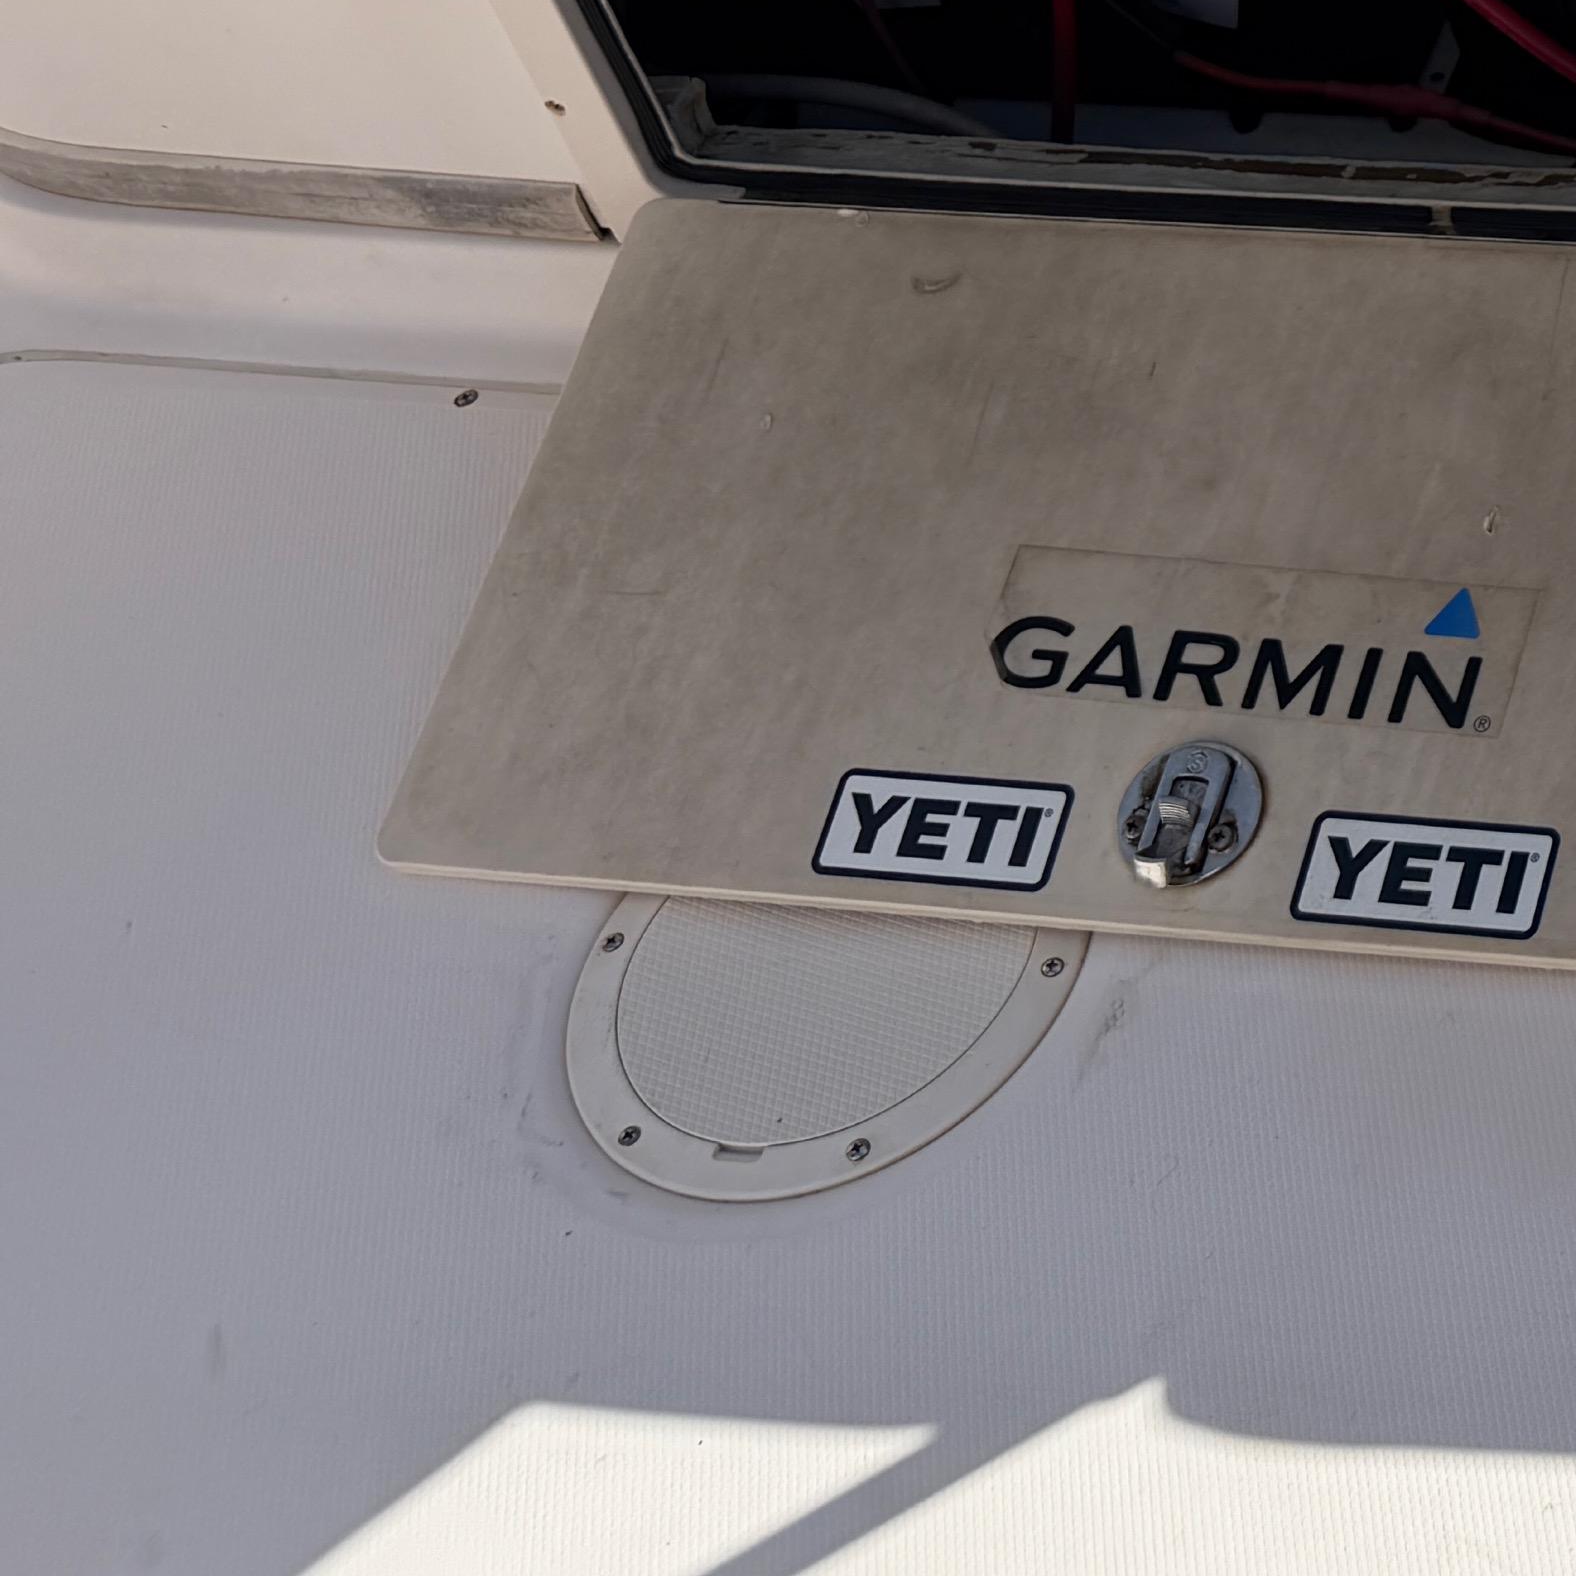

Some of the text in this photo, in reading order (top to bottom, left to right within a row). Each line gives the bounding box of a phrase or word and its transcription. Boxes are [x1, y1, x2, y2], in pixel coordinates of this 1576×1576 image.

[989, 614, 1485, 730] GARMIN
[851, 791, 1045, 869] YETI
[1327, 835, 1532, 915] YETI
